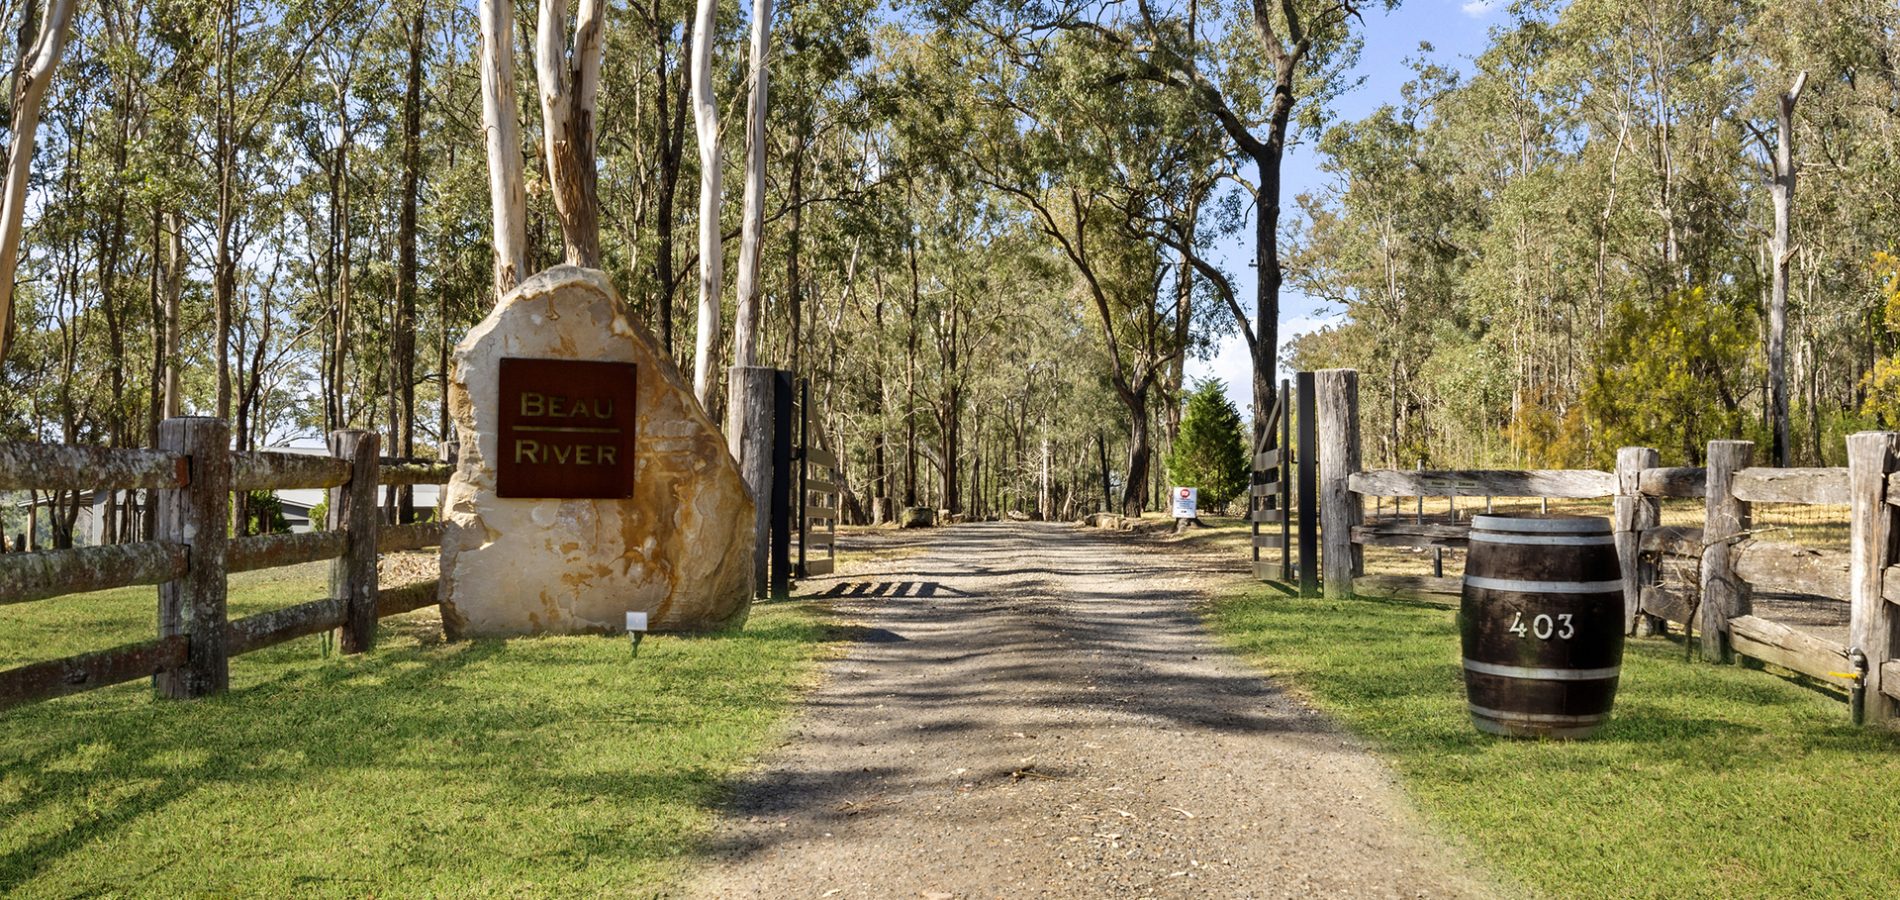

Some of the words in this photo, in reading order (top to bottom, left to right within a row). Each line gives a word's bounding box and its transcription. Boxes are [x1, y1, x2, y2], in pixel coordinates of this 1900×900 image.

[520, 392, 613, 419] BEAU
[515, 439, 617, 465] RIVER
[1509, 612, 1575, 640] 403
